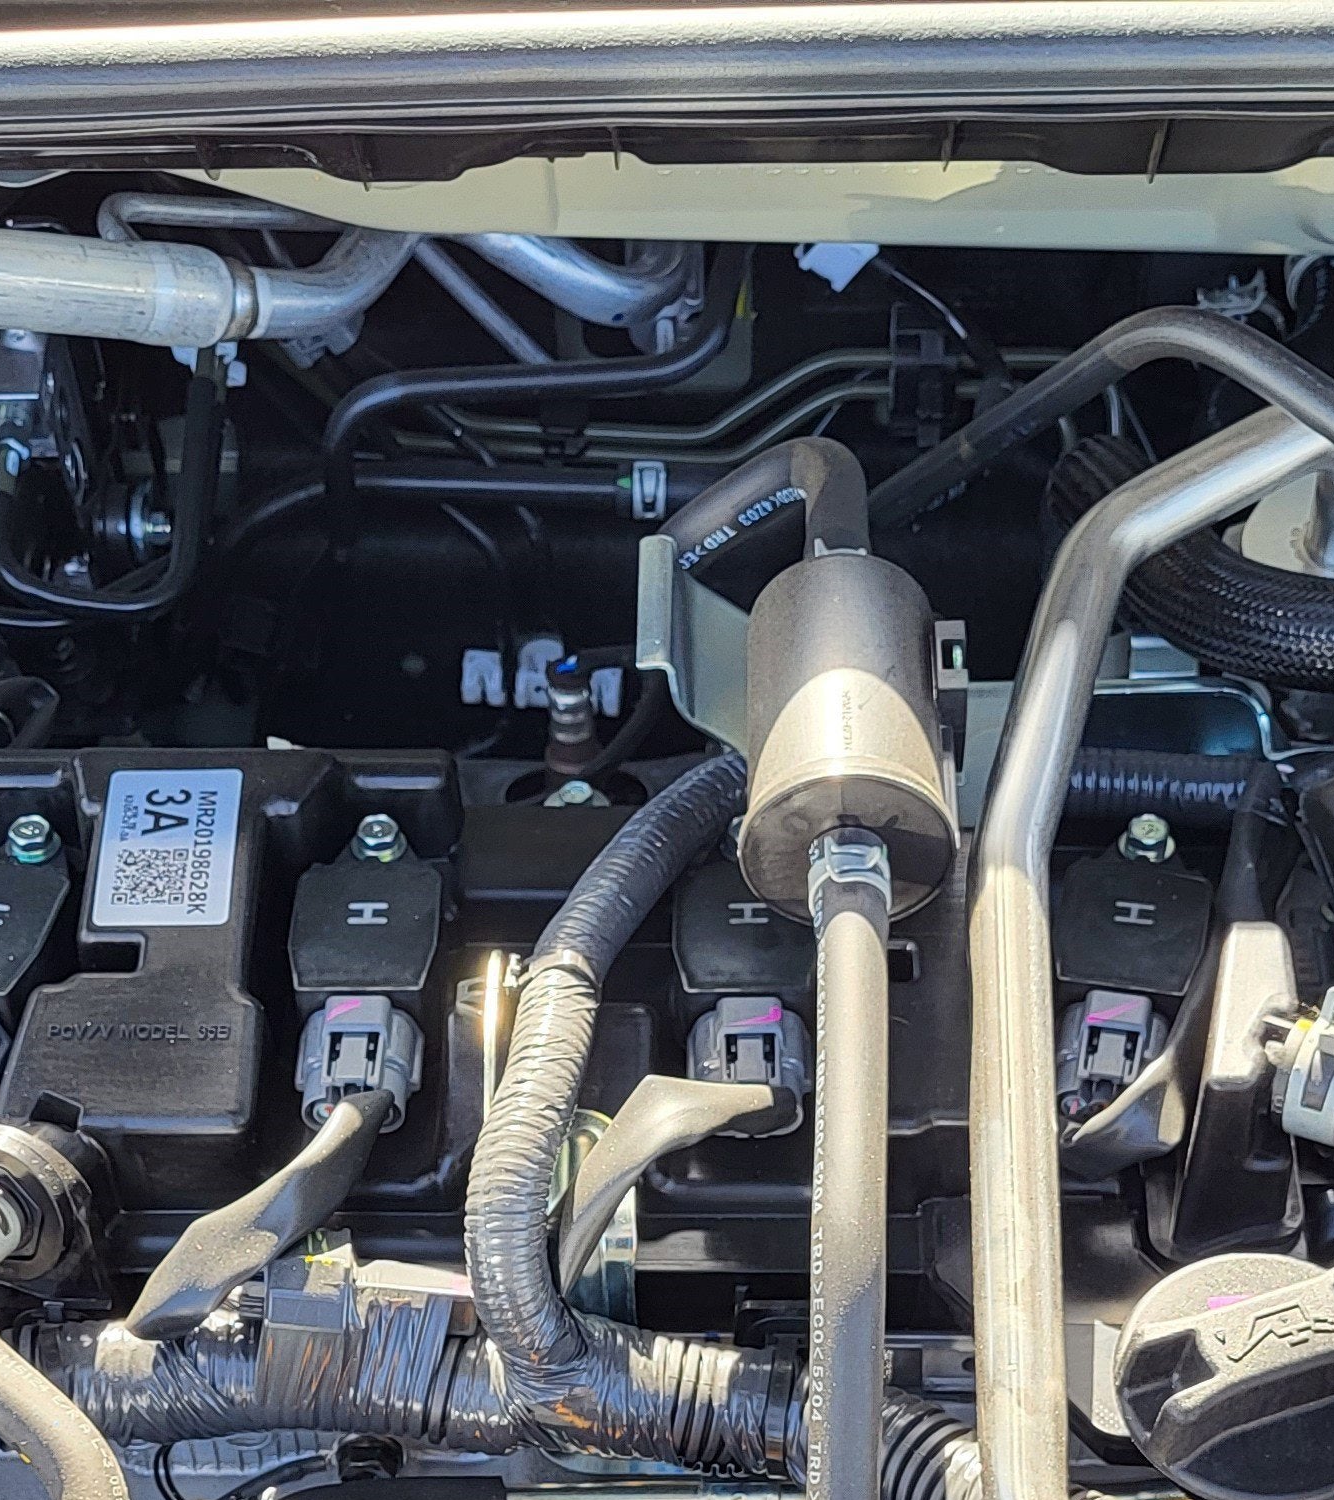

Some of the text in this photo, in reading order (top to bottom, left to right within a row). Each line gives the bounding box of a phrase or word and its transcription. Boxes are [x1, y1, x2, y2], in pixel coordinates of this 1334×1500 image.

[141, 788, 193, 837] 3A
[186, 790, 218, 915] MR20198628K
[346, 901, 390, 925] H
[727, 902, 769, 925] H
[1113, 901, 1156, 925] H
[119, 1022, 191, 1042] MODEL
